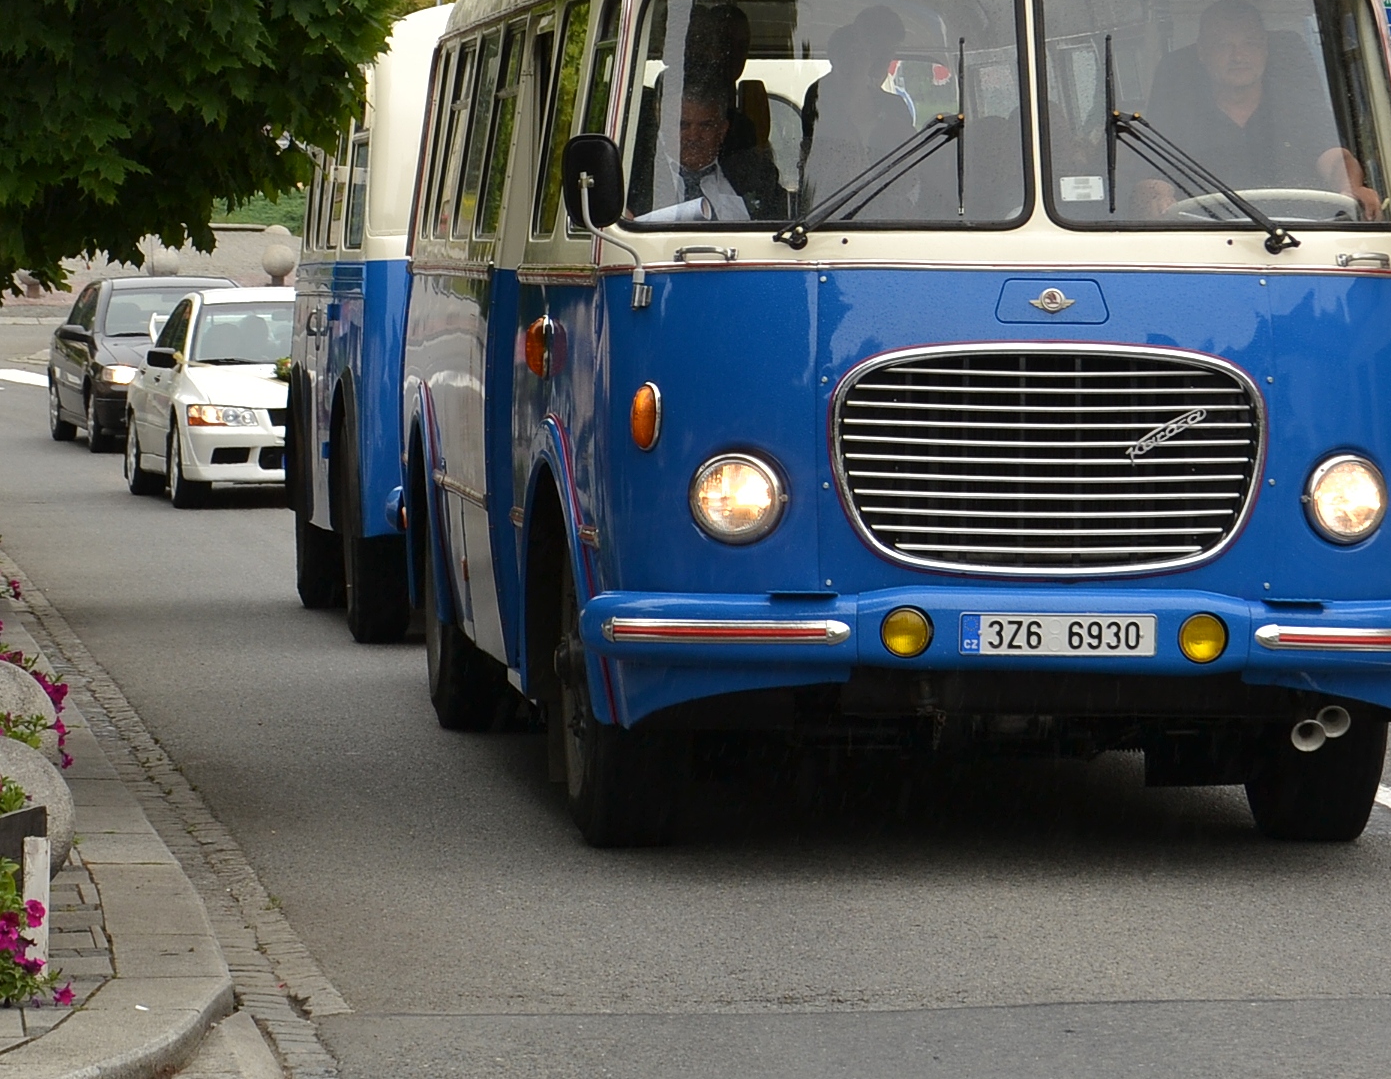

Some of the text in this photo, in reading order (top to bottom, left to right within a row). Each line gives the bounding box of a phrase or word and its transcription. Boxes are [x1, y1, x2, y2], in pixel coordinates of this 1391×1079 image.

[963, 639, 979, 649] CZ
[987, 620, 1141, 650] 3Z6 6930
